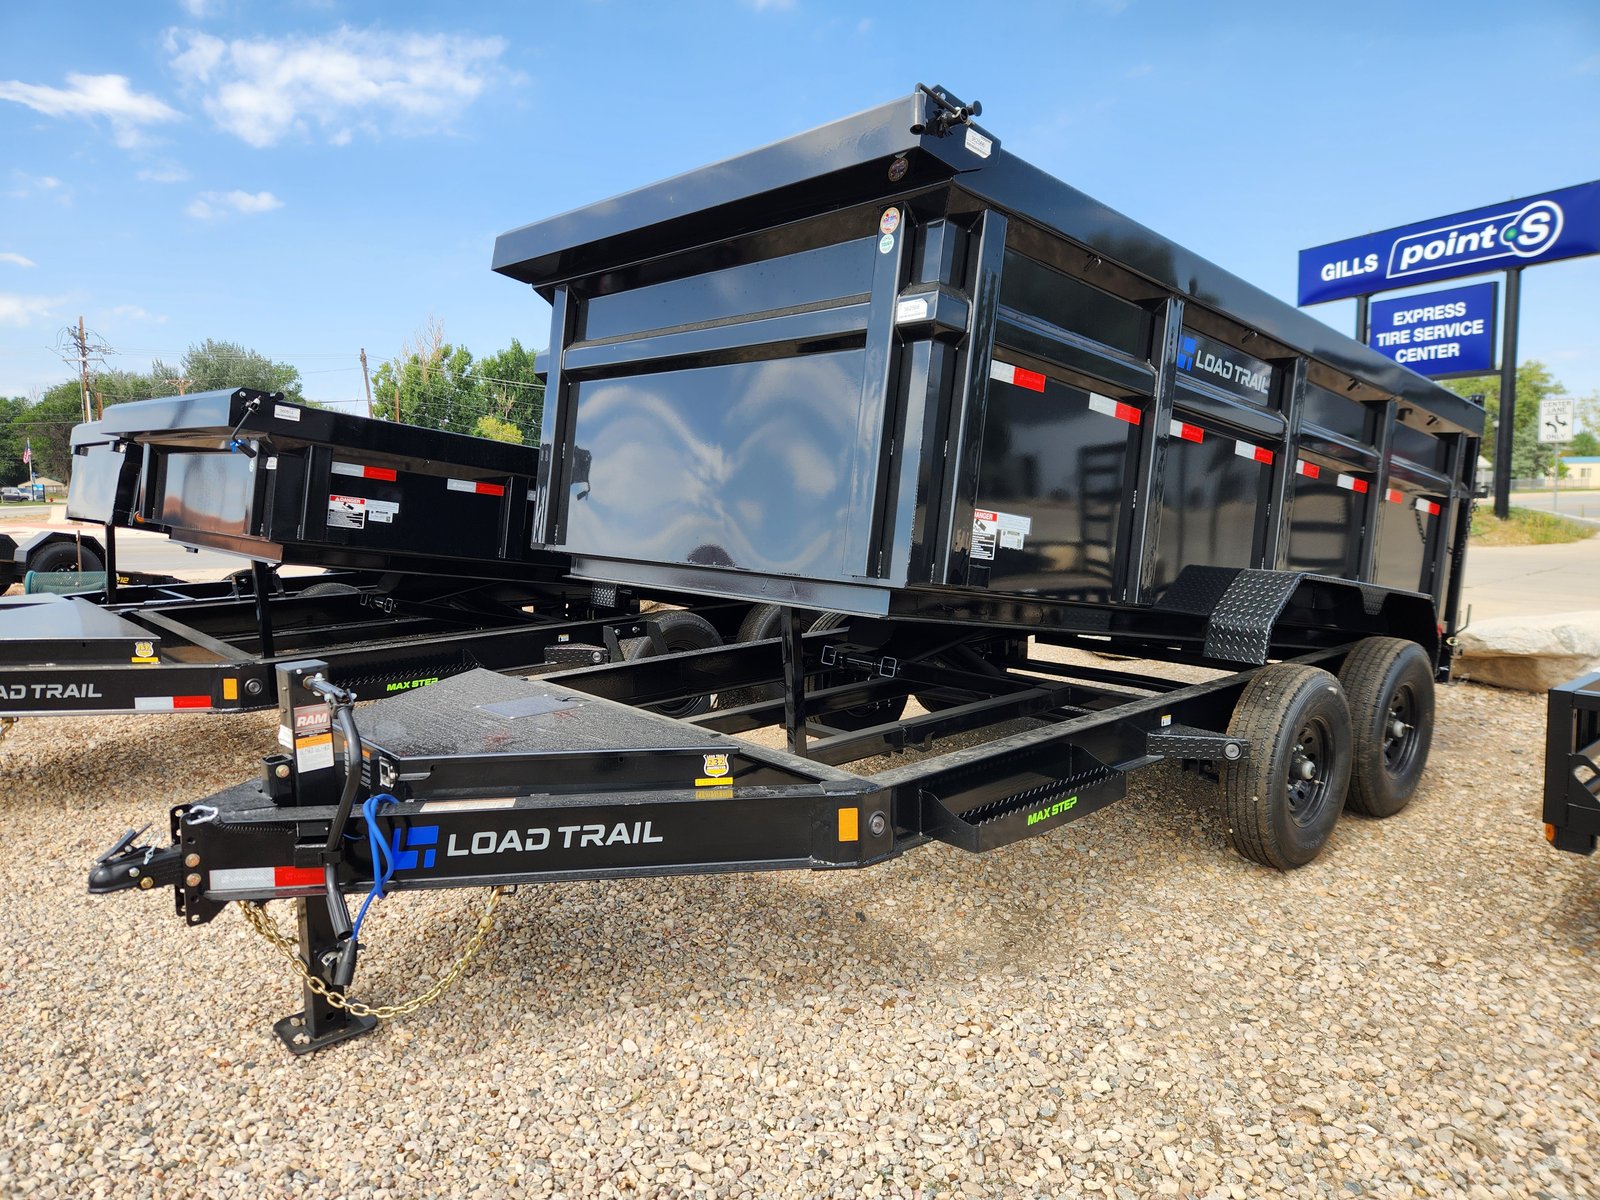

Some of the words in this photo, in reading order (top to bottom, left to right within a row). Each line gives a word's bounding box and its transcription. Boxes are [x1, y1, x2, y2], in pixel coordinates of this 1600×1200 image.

[1321, 254, 1378, 281] GILLS
[1400, 225, 1498, 269] point
[1393, 302, 1466, 326] EXPRESS
[1376, 333, 1410, 347] TIRE
[1413, 319, 1484, 343] SERVICE
[1395, 343, 1460, 364] CENTER
[1195, 349, 1233, 379] LOAD
[1234, 365, 1270, 394] TRAIL
[31, 683, 103, 699] TRAIL
[387, 682, 410, 691] MAX
[412, 677, 438, 688] STEP
[297, 713, 328, 727] RAM
[1028, 807, 1051, 826] MAX
[1051, 796, 1077, 816] STEP
[447, 828, 550, 857] LOAD
[558, 821, 664, 848] TRAIL
